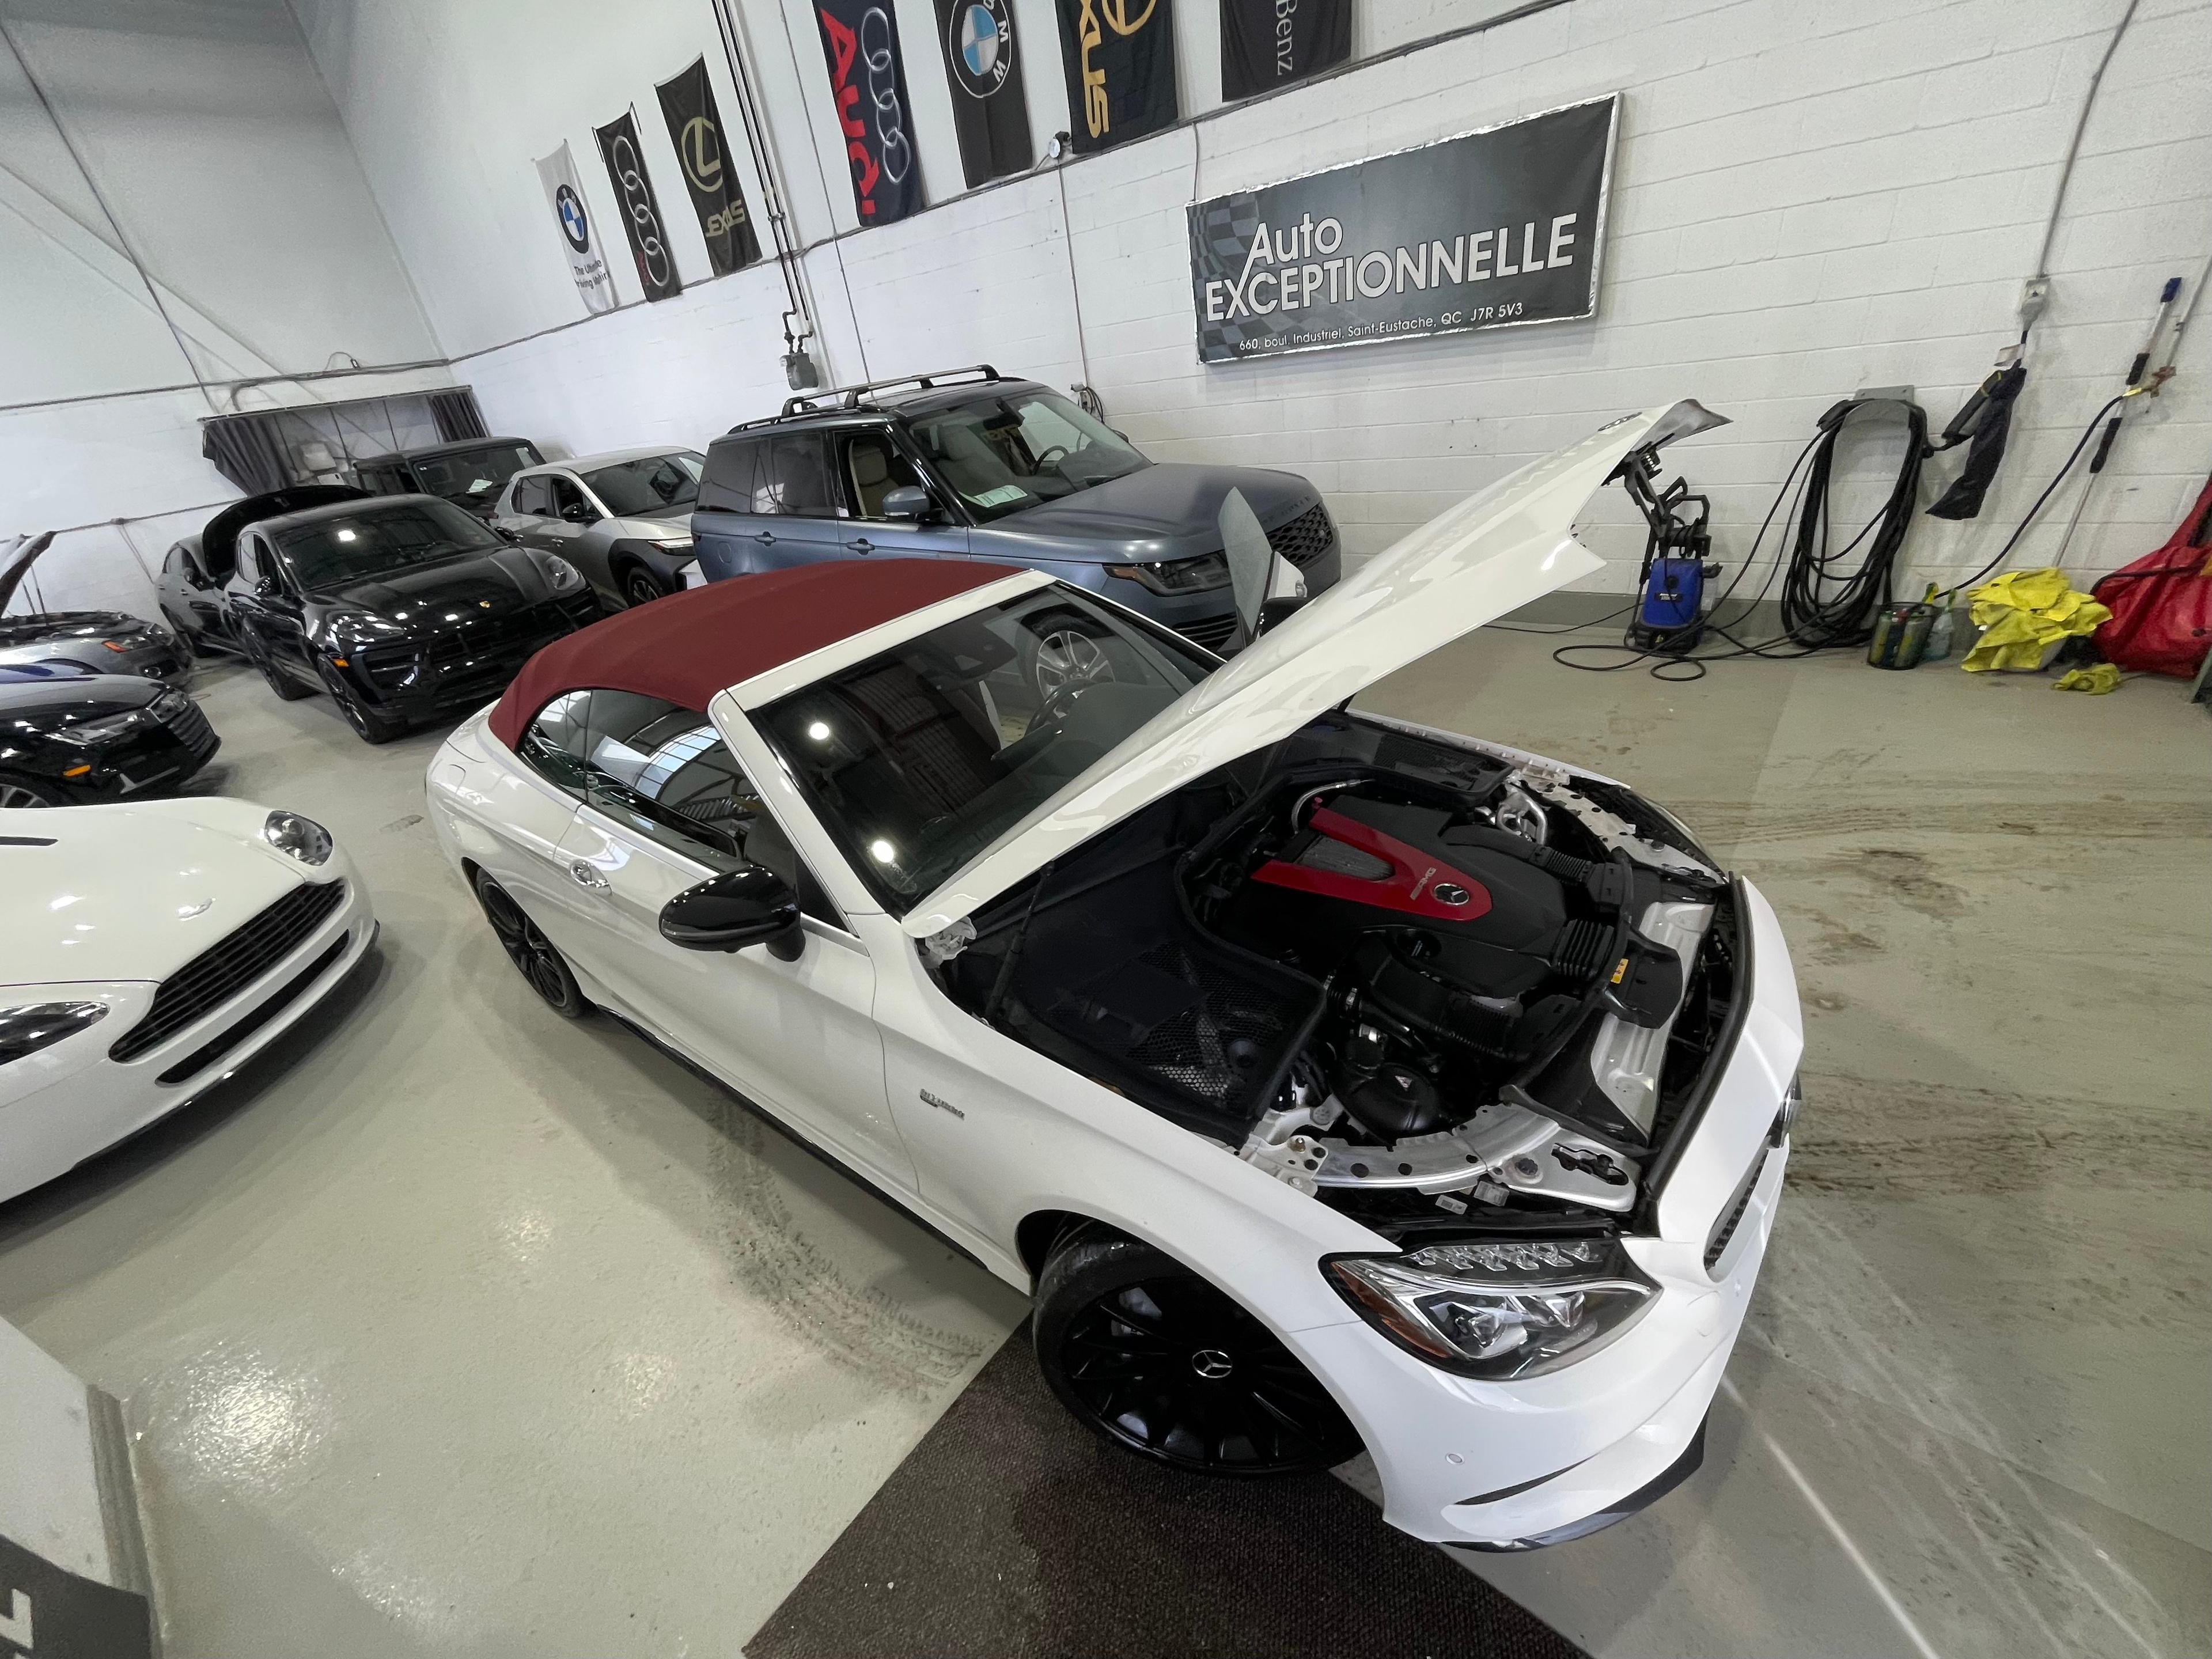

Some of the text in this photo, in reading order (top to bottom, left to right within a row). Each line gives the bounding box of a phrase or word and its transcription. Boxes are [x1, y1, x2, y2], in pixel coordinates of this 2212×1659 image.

[1206, 213, 1577, 322] EXCEPTIONNELLE
[1242, 212, 1343, 278] Auto
[1239, 338, 1262, 351] 660,
[1264, 335, 1290, 347] boul.
[1348, 316, 1437, 338] Saint-Eustache,
[1441, 311, 1462, 325] QC
[1471, 306, 1494, 321] J7R
[1498, 302, 1523, 317] 5V3
